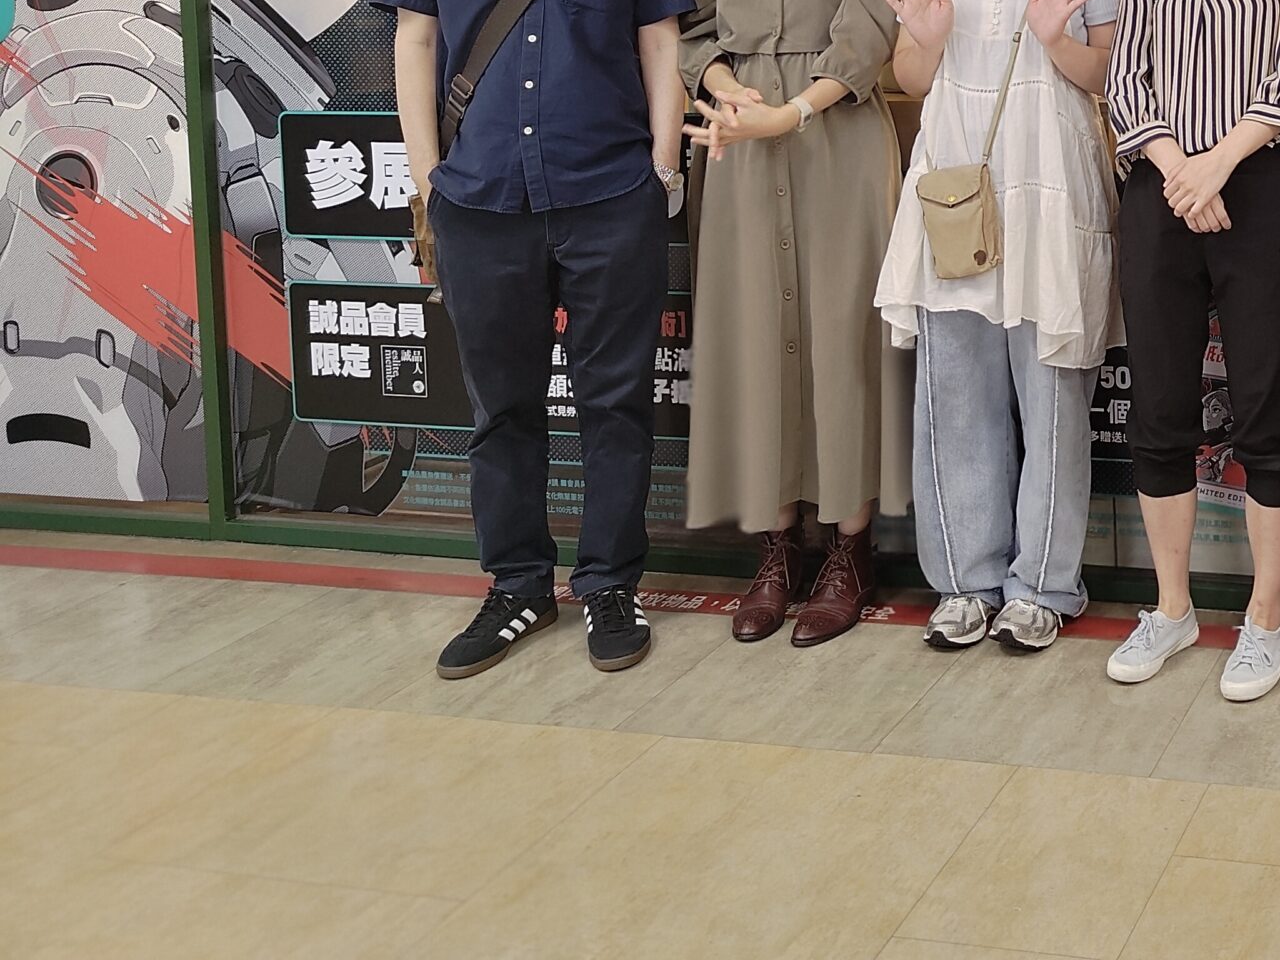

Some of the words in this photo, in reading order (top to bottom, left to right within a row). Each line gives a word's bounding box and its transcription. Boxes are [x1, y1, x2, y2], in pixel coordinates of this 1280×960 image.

[308, 299, 427, 339] 誠品會員
[310, 341, 372, 378] 限定
[384, 349, 396, 392] member
